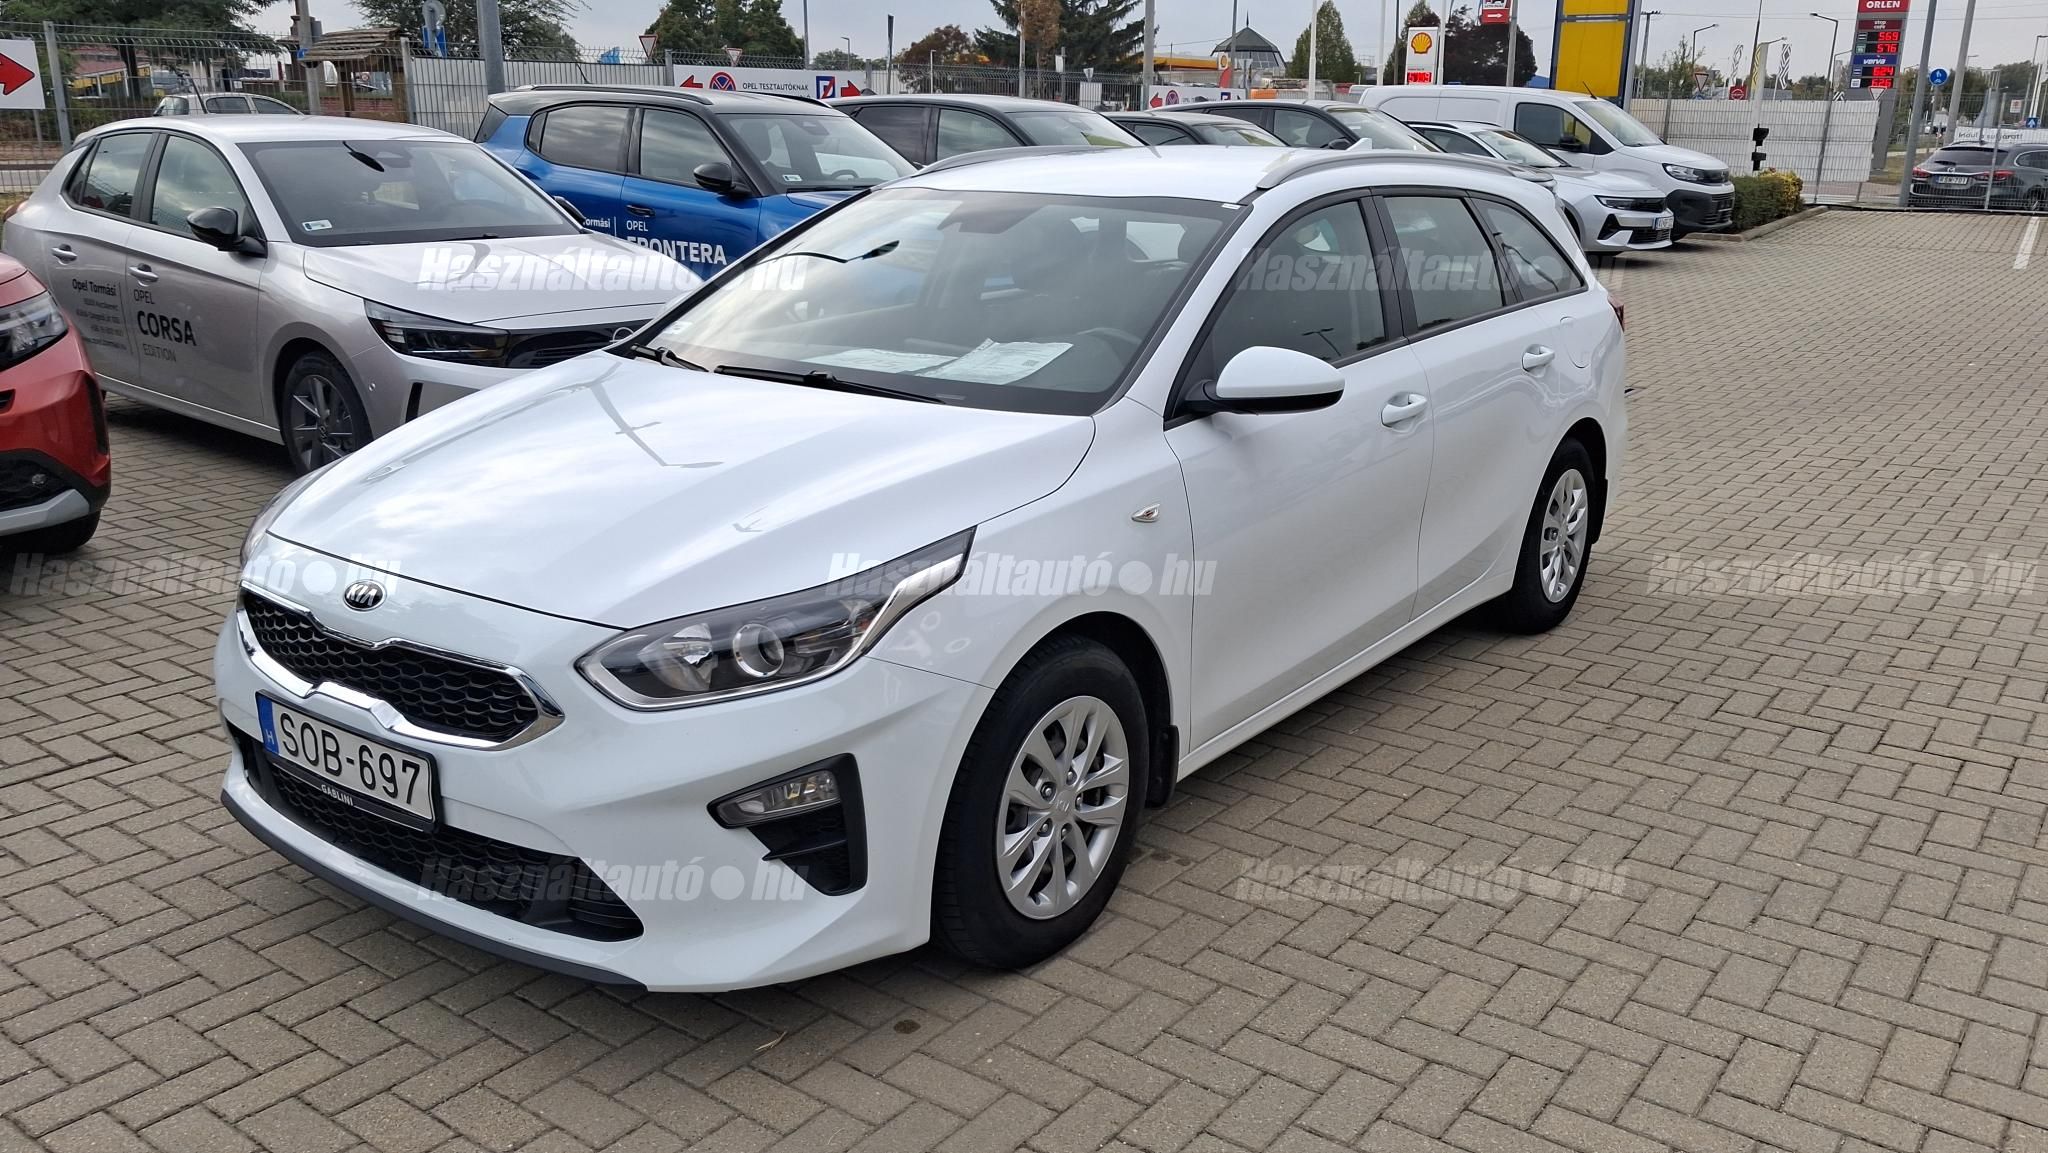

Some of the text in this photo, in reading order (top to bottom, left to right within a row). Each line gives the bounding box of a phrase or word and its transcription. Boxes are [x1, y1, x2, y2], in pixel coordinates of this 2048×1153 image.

[1866, 1, 1900, 9] ORLEN
[1878, 32, 1899, 41] 569
[1877, 44, 1897, 53] 576
[742, 81, 809, 91] OPEL TESZTAUTÓKNAK
[626, 219, 649, 232] OPEL
[72, 278, 117, 297] Opel Tormási
[133, 288, 156, 305] OPEL
[136, 309, 198, 347] CORSA
[142, 343, 177, 362] EDITION
[346, 583, 378, 607] KIA
[265, 731, 275, 746] H
[279, 712, 421, 805] SOB-697
[320, 783, 355, 807] GABLINI
